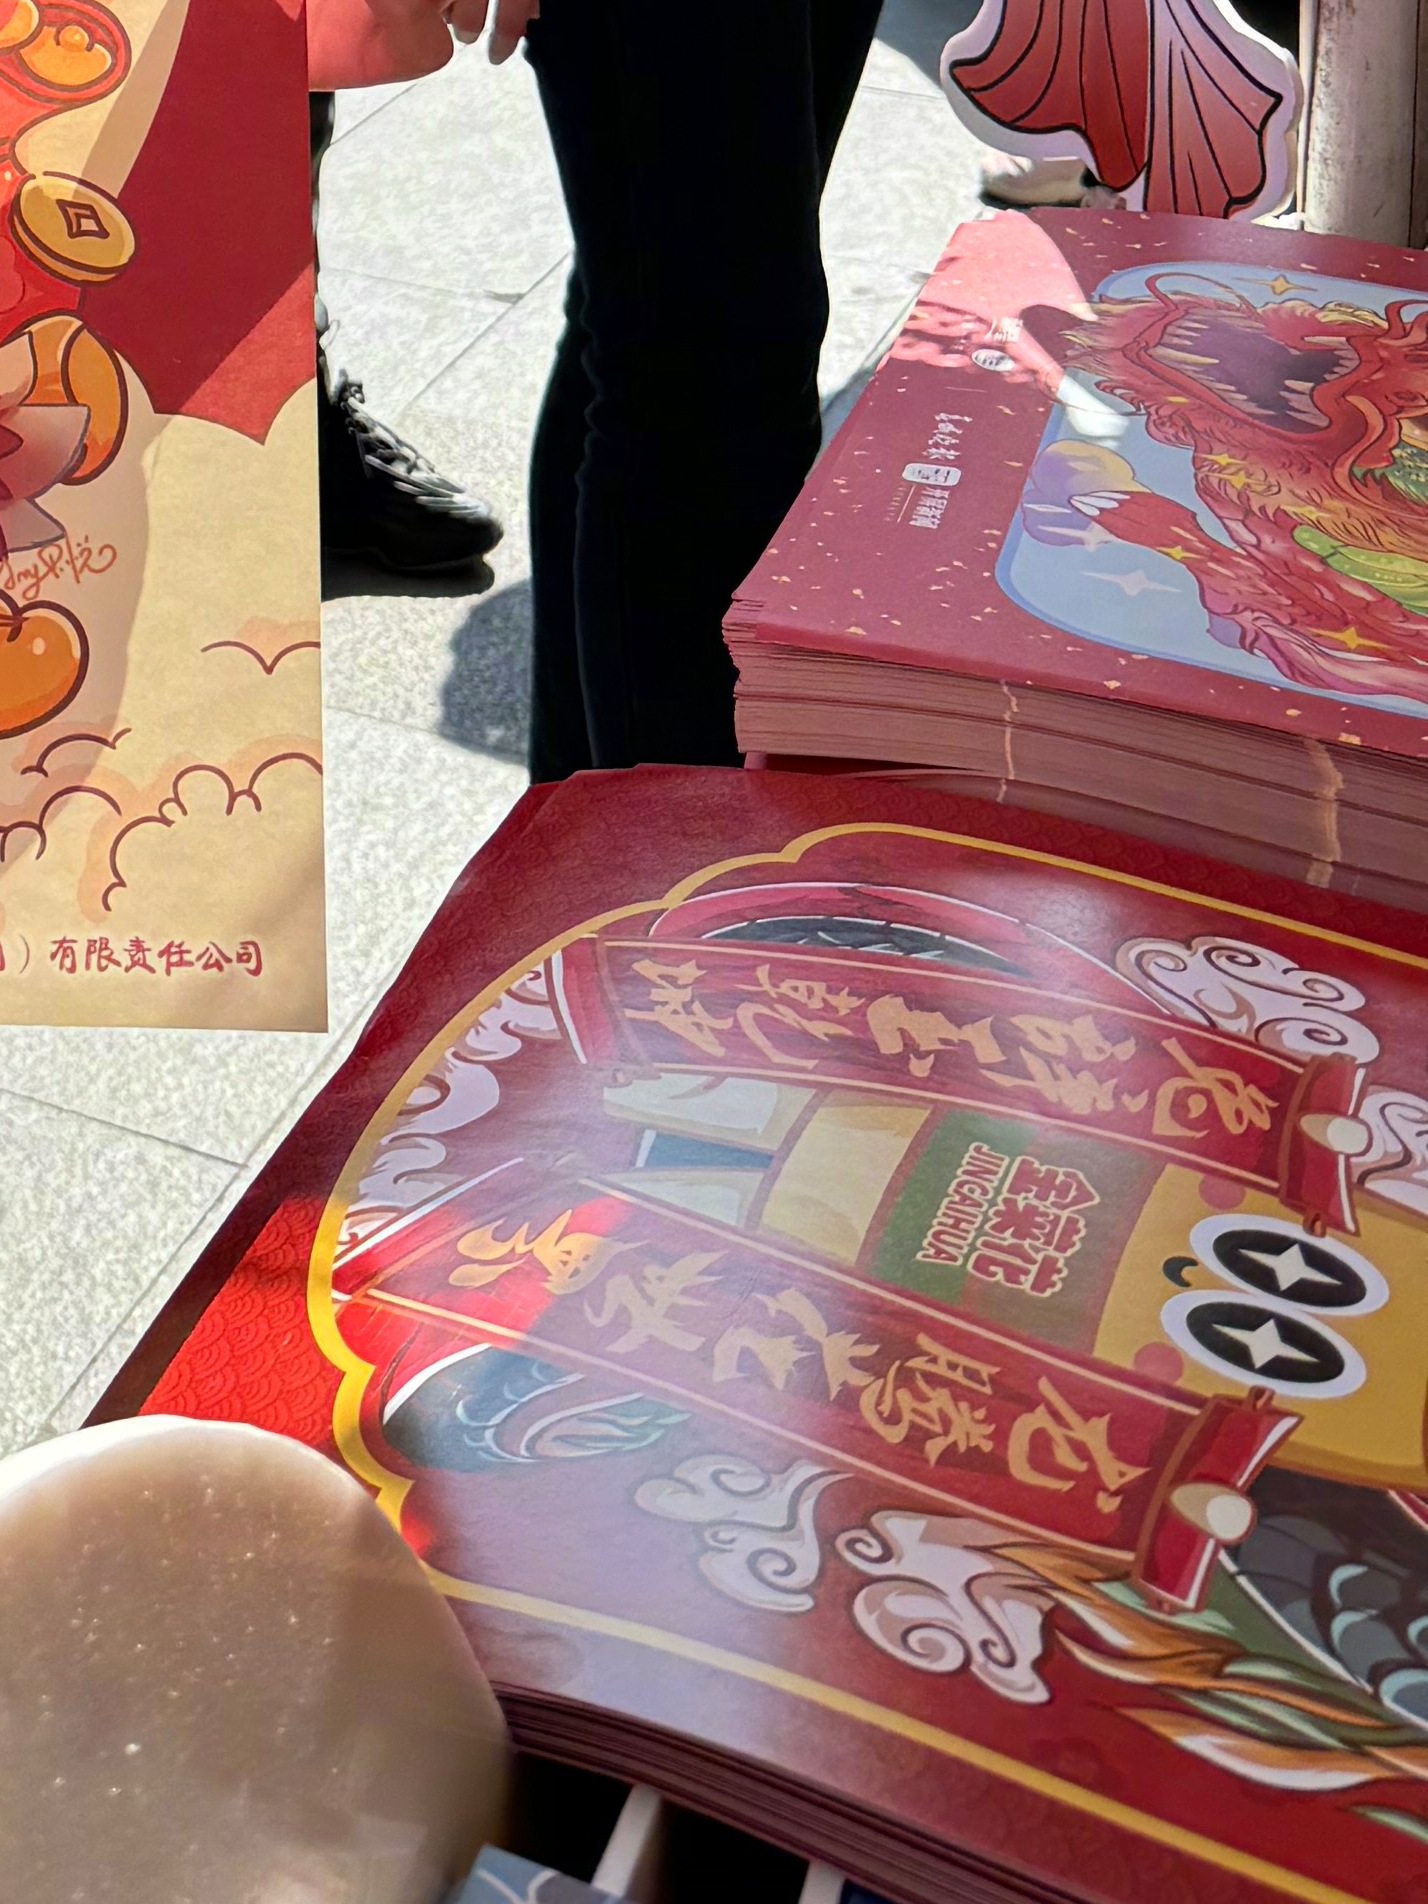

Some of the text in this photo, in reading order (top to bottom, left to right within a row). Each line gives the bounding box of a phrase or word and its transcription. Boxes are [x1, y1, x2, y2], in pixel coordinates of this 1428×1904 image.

[915, 1141, 1010, 1267] JINCAIHUA
[967, 1155, 1101, 1298] 金菜花
